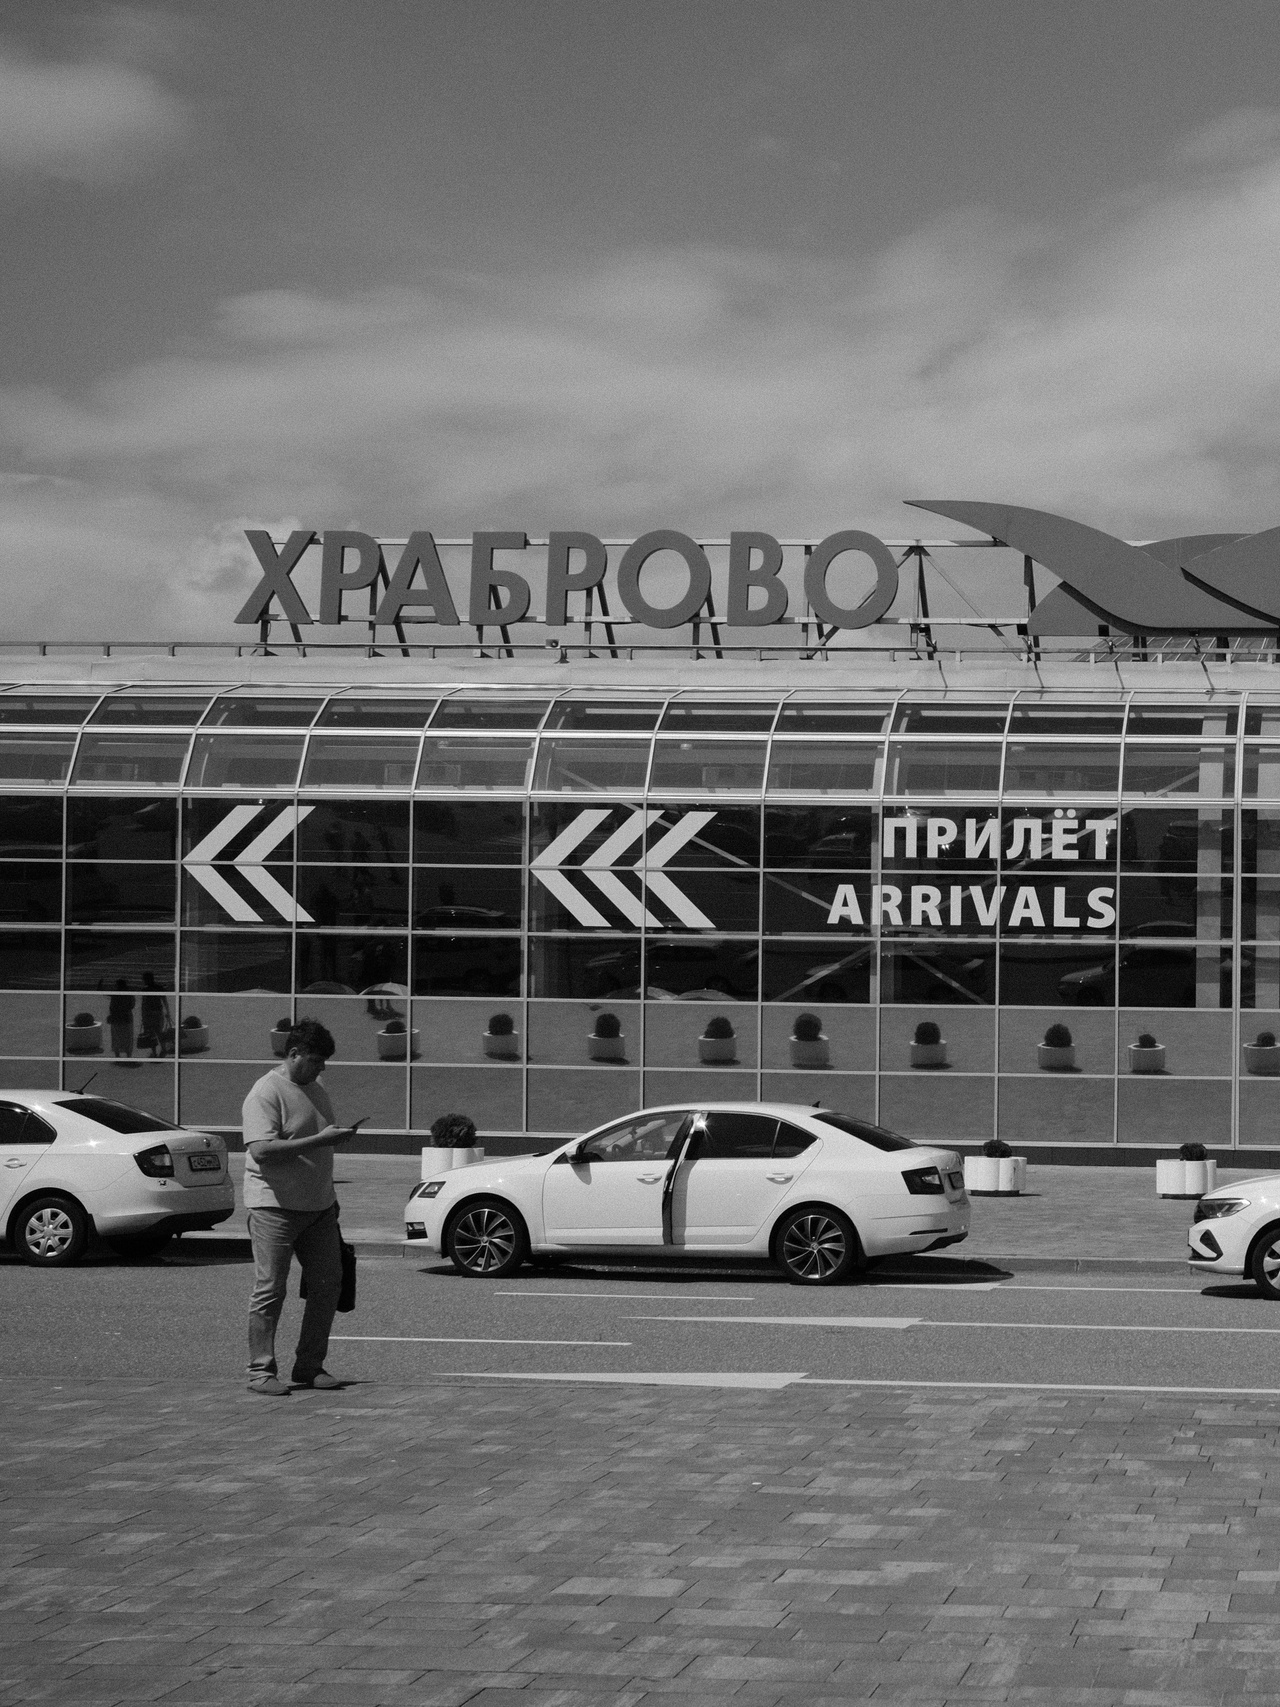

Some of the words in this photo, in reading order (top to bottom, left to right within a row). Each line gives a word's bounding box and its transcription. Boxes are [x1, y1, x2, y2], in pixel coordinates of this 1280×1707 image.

[233, 529, 899, 630] ХРАБРОВО
[882, 808, 1117, 860] ПРИЛЁТ
[826, 883, 1117, 929] ARRIVALS
